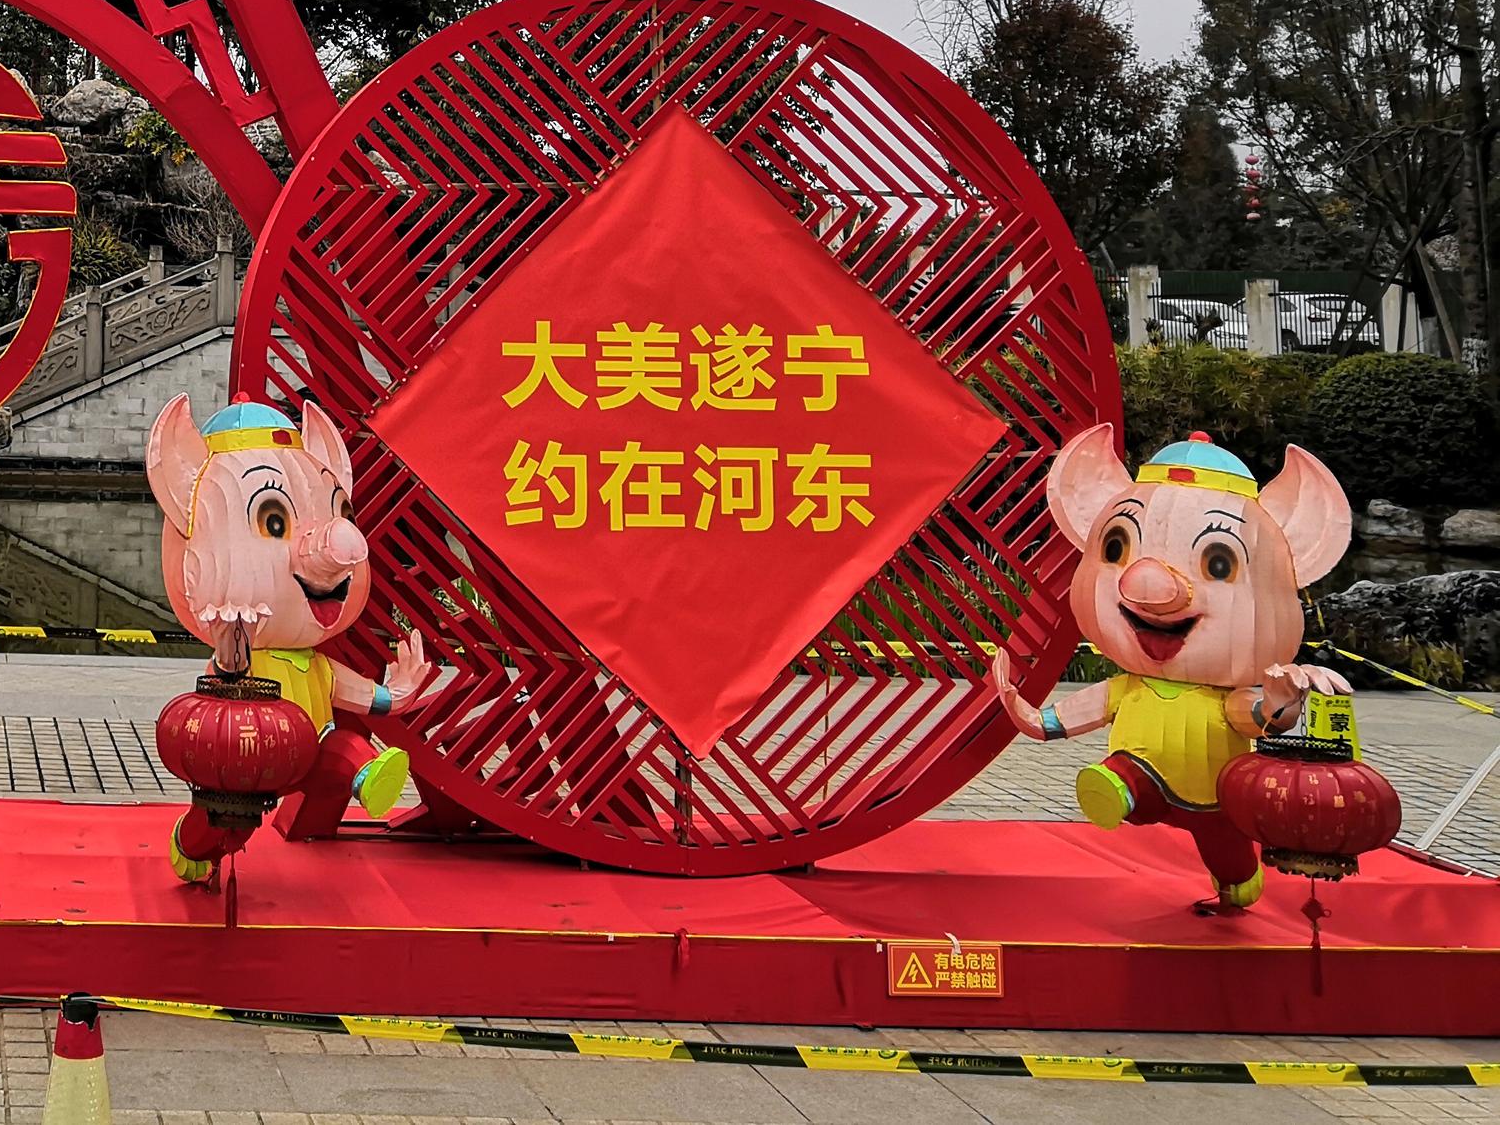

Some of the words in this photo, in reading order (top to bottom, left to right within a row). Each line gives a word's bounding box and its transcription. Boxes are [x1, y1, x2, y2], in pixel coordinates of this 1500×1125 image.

[502, 321, 870, 412] 大美遂宁
[503, 440, 876, 532] 约在河东
[934, 953, 996, 970] 有电危险
[935, 972, 997, 989] 严禁触碰
